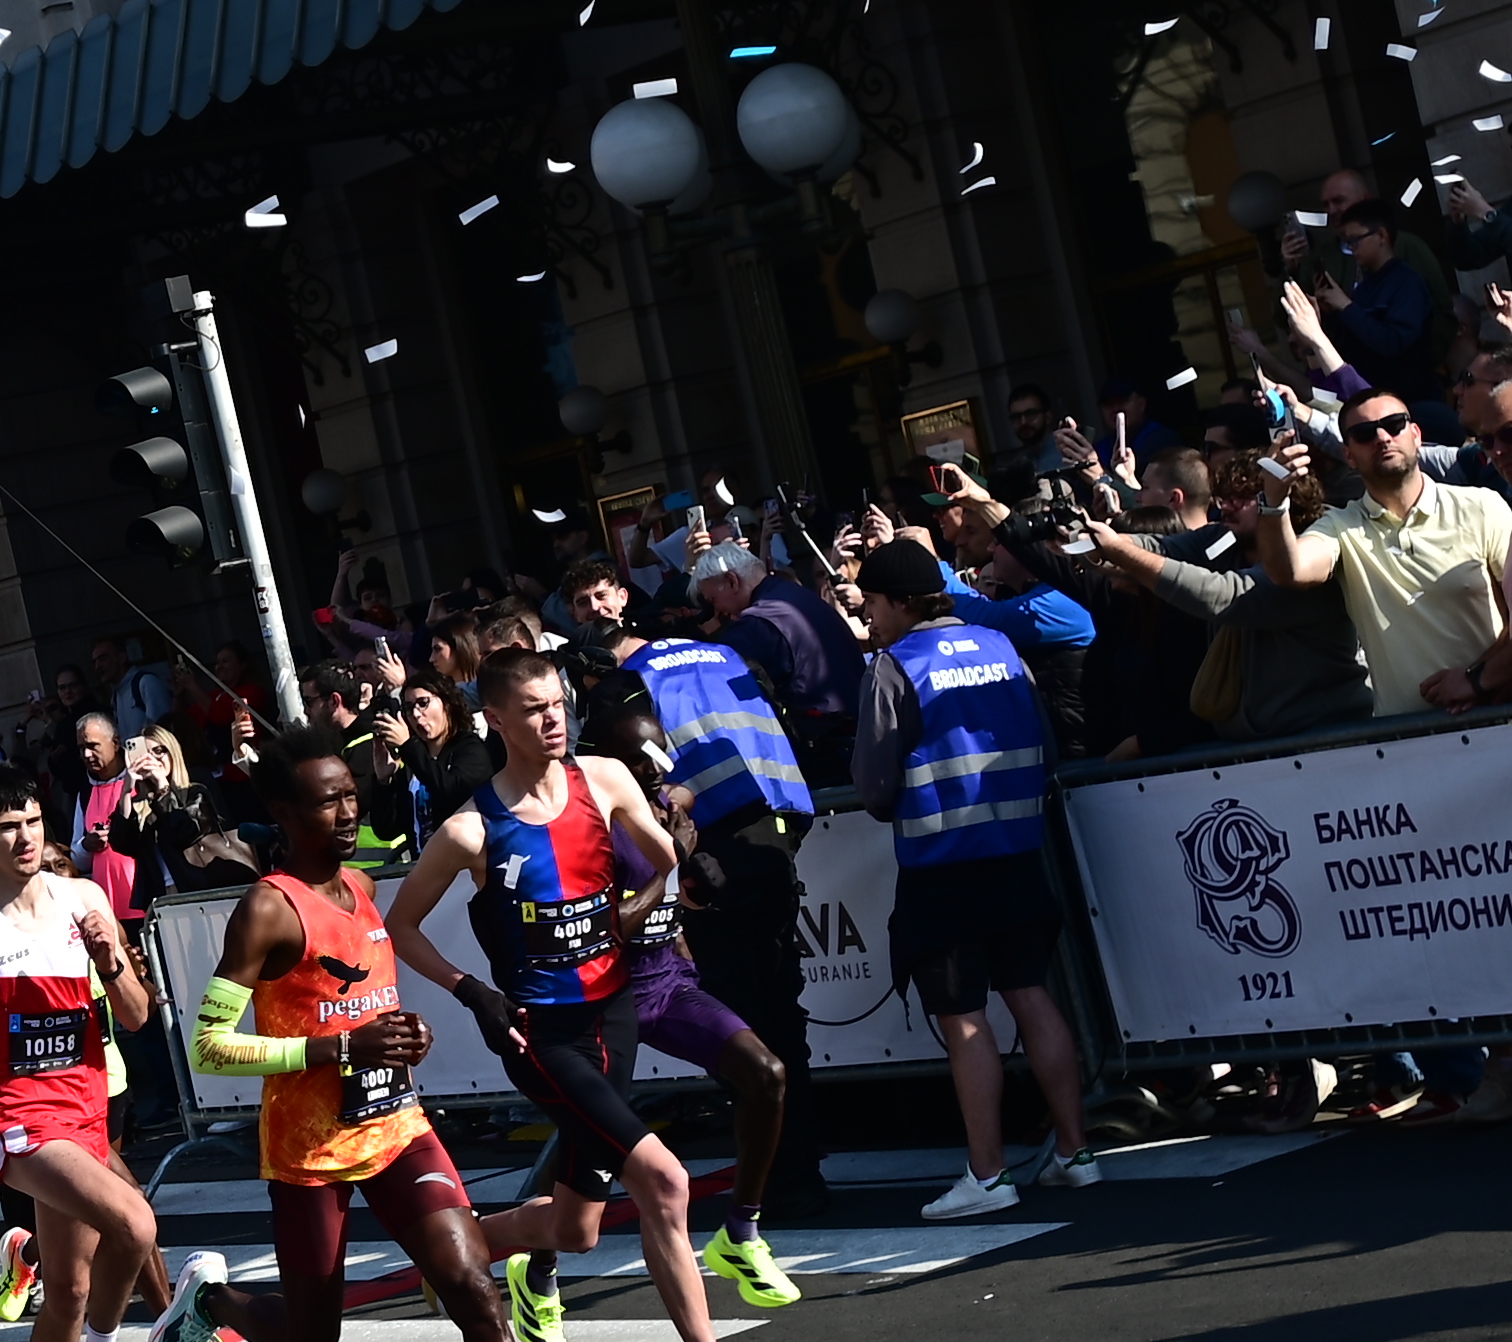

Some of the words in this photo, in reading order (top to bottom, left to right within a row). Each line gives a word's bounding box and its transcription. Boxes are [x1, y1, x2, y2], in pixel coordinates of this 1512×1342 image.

[648, 649, 727, 672] BROADCAST
[930, 663, 1011, 691] BROADCAST
[1313, 801, 1417, 846] БАНКА
[554, 918, 592, 939] 4010
[794, 901, 867, 959] AVA
[1236, 969, 1295, 1003] 1921
[26, 1034, 75, 1057] 10158
[361, 1068, 393, 1089] 4007
